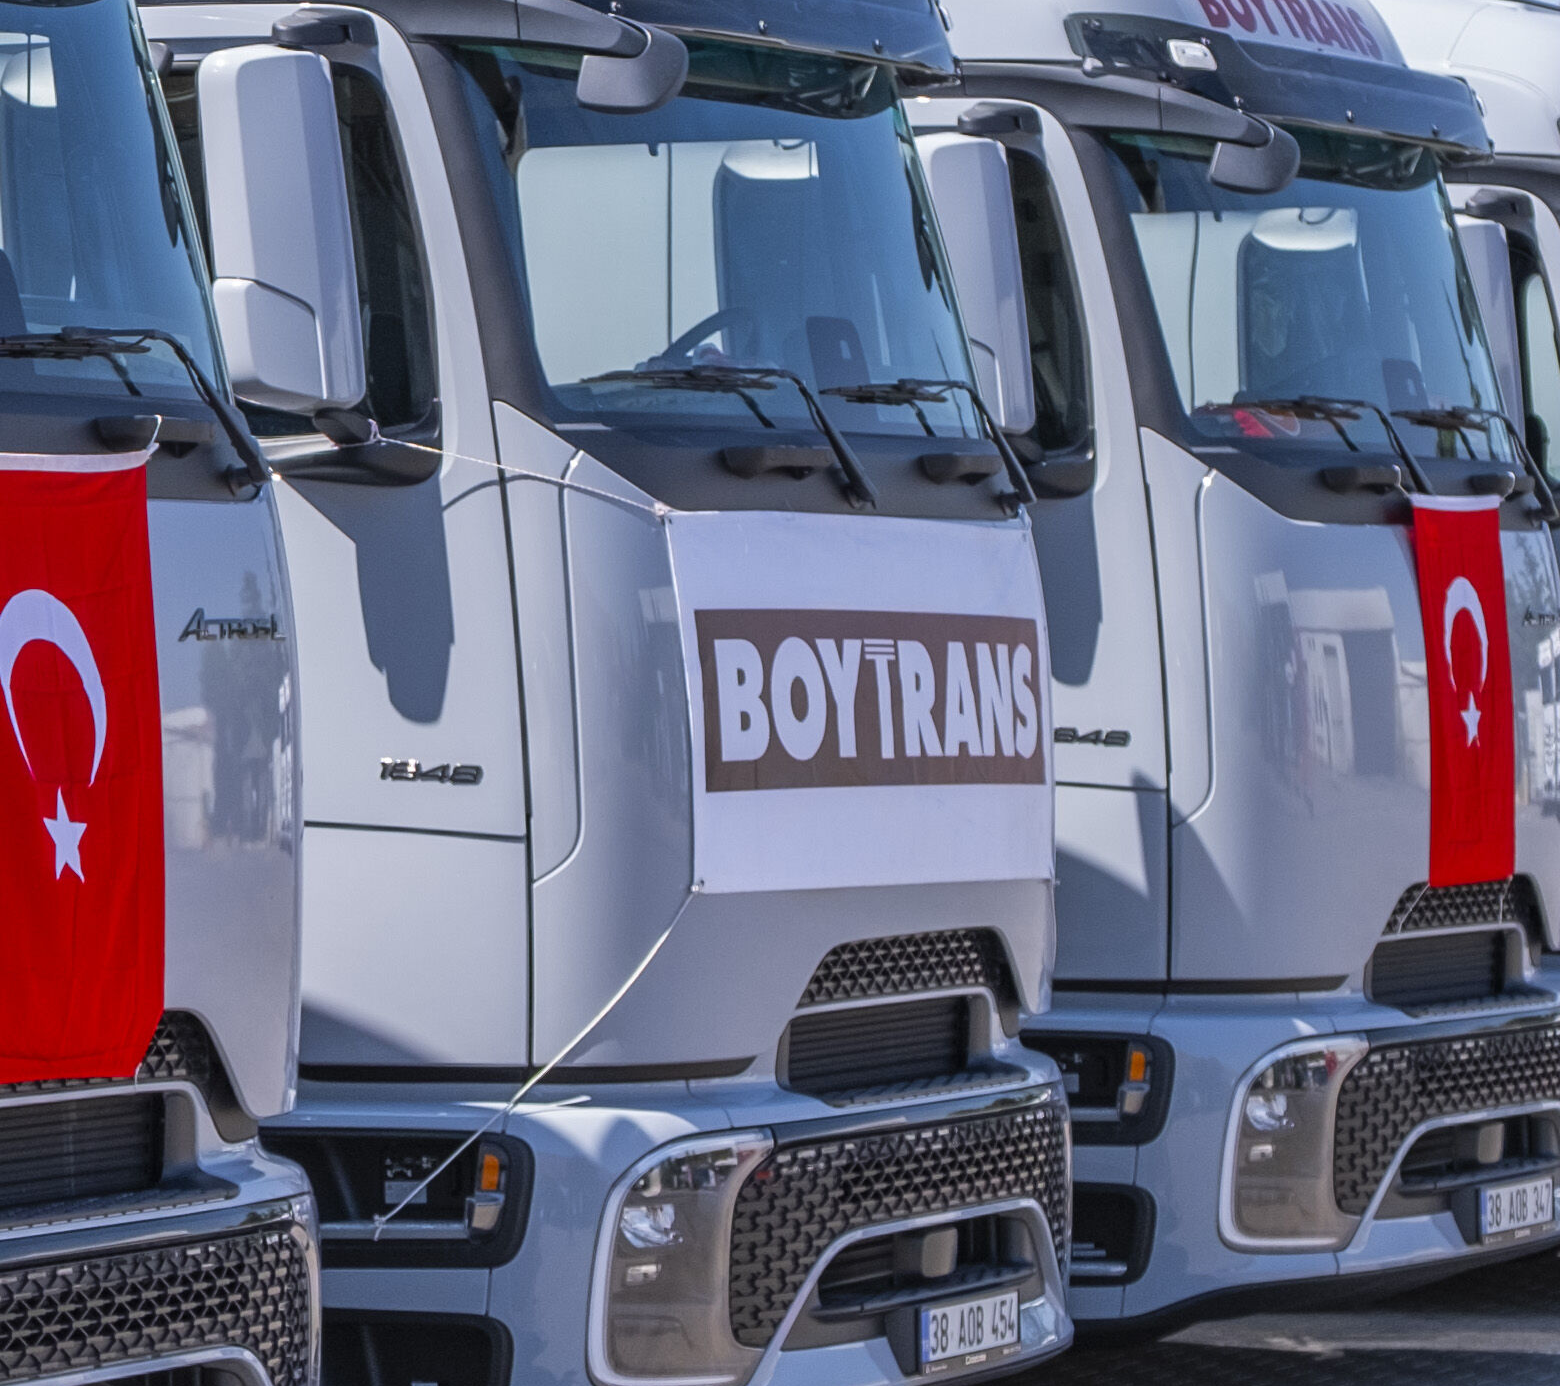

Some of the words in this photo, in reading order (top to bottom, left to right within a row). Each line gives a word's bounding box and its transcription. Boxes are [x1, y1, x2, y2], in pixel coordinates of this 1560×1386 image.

[713, 635, 1038, 762] BOYTRANS
[1488, 1192, 1502, 1227] 38
[1509, 1188, 1528, 1224] AOB
[931, 1312, 949, 1355] 38
[959, 1305, 984, 1349] AOB
[991, 1298, 1015, 1341] 454
